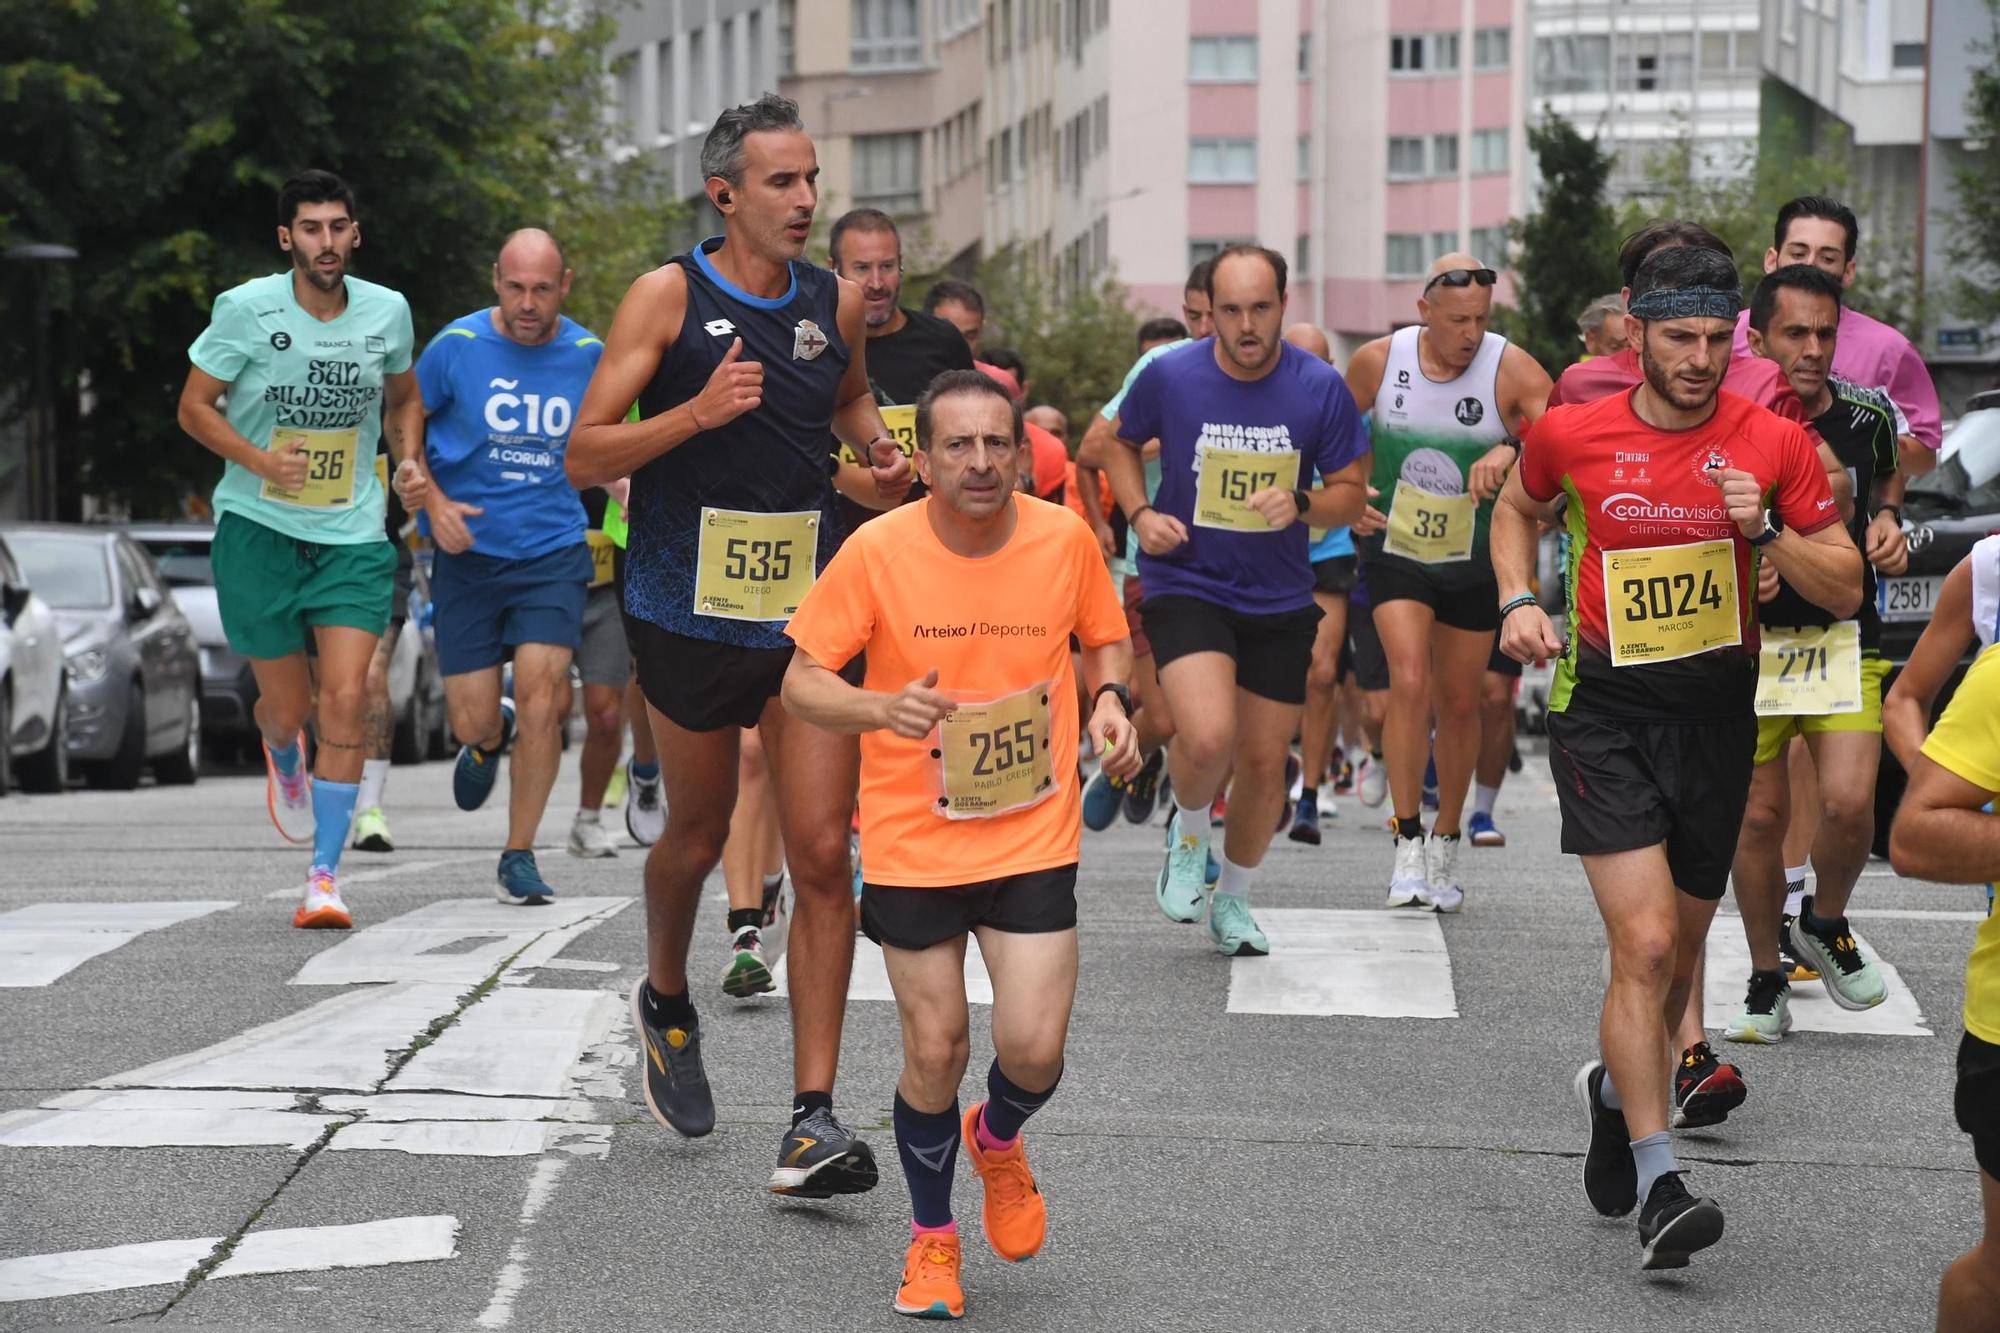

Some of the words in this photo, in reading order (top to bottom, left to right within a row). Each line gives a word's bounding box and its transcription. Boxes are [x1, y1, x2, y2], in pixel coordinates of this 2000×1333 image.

[307, 359, 361, 386] SAN
[264, 384, 382, 410] SILVESTR
[488, 447, 500, 460] A
[1221, 469, 1277, 502] 1517
[1413, 508, 1449, 539] 33
[1629, 521, 1681, 536] clínica
[725, 538, 793, 582] 535
[744, 585, 771, 595] DIEGO
[1623, 569, 1722, 622] 3024
[1889, 580, 1931, 610] 2581
[913, 624, 967, 638] Arteixo
[980, 622, 1047, 638] Deportes
[1658, 620, 1694, 633] MARCOS
[1636, 645, 1665, 654] BARRIOS
[1777, 646, 1828, 683] 271
[969, 718, 1034, 776] 255
[974, 777, 1002, 790] PABLO
